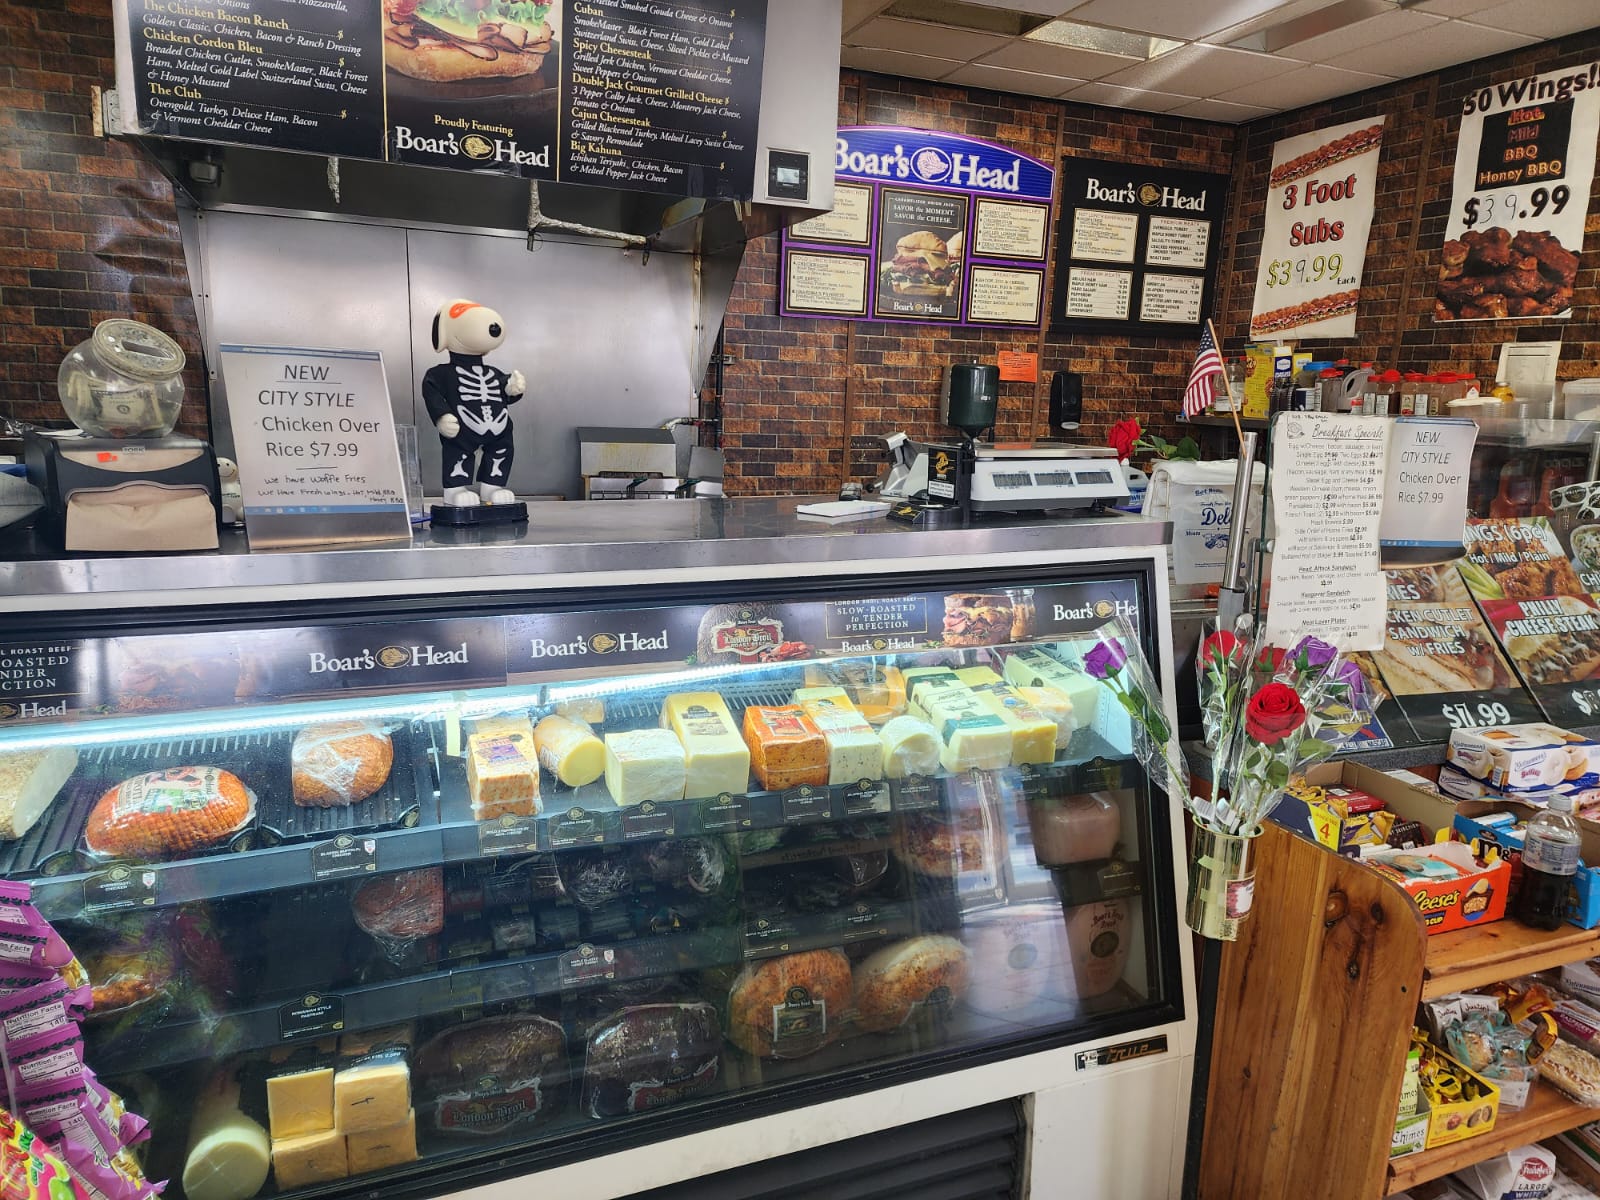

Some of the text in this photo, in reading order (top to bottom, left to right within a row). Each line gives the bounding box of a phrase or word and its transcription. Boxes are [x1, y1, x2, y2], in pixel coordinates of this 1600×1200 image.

[144, 0, 289, 30] The Chicken Bacon Ranch
[574, 2, 604, 17] Cuban
[143, 14, 176, 26] Golden
[256, 29, 282, 42] Bacon
[296, 36, 324, 48] Ranch
[326, 40, 362, 56] Dressing
[144, 27, 263, 54] Chicken Cordon Bleu
[573, 38, 652, 60] Spicy Cheesesteak
[145, 42, 182, 56] Breaded
[184, 48, 220, 61] Chicken
[319, 66, 342, 79] Black
[344, 70, 368, 82] Forest
[160, 70, 230, 88] Honey Mustard
[176, 59, 207, 72] Melted
[210, 64, 232, 76] Gold
[234, 67, 259, 80] Label
[260, 71, 312, 88] Switzerland
[340, 82, 368, 95] Cheese
[148, 82, 202, 98] The Club
[572, 72, 724, 104] Double Jack Gourmet Grilled Cheese
[1464, 63, 1600, 116] 50 Wings!
[164, 112, 272, 134] Vermont Cheddar Cheese
[232, 107, 262, 120] Deluxe
[292, 114, 318, 126] Bacon
[572, 106, 652, 127] Cajun Cheesesteak
[1508, 106, 1545, 125] Hot
[434, 114, 514, 138] Proudly Featuring
[395, 126, 550, 168] Boar's Head
[571, 140, 622, 156] Big Kahuna
[1504, 144, 1538, 162] BBQ
[834, 138, 1020, 192] Boar's Head
[1480, 160, 1562, 186] Honey BBQ
[1086, 178, 1206, 212] Boar's Head
[1283, 174, 1357, 210] 3 Foot
[1290, 218, 1345, 248] Subs
[1266, 253, 1357, 288] $39.99 Each
[924, 304, 942, 314] Head
[284, 365, 330, 380] NEW
[258, 390, 355, 408] CITY STYLE
[262, 416, 380, 433] Chicken Over
[1312, 424, 1352, 441] Breakfast
[1416, 432, 1441, 444] NEW
[266, 441, 358, 458] Rice $7.99
[1400, 452, 1451, 464] CITY STYLE
[1400, 472, 1462, 485] Chicken Over
[1399, 492, 1444, 504] Rice $7.99
[1201, 507, 1231, 526] Del
[1464, 523, 1548, 546] INGS (6pc)
[1469, 552, 1550, 564] Hot Mild Plain
[1387, 584, 1420, 600] RIES
[837, 604, 916, 616] SLOW-ROASTED
[862, 613, 904, 622] TENDER
[1053, 600, 1138, 620] Boar's He
[1386, 608, 1474, 623] CKEN CUTLET
[1518, 600, 1564, 618] PHILLY
[846, 620, 909, 632] PERFECTION
[1389, 625, 1466, 640] SANDWICH
[1506, 614, 1600, 638] CHEESE STEAK
[531, 630, 669, 659] Boar's Head
[842, 636, 915, 653] Boar's Head
[1426, 641, 1466, 656] FRIES
[2, 656, 69, 668] OASTED
[309, 644, 468, 673] Boar's Head
[0, 668, 47, 680] NDER
[20, 700, 67, 718] Head
[1320, 823, 1330, 839] 4
[6, 1002, 62, 1026] Nutrition Facts
[20, 1050, 73, 1072] Nutrition Facts
[64, 1066, 80, 1078] 140
[68, 1116, 84, 1126] 140
